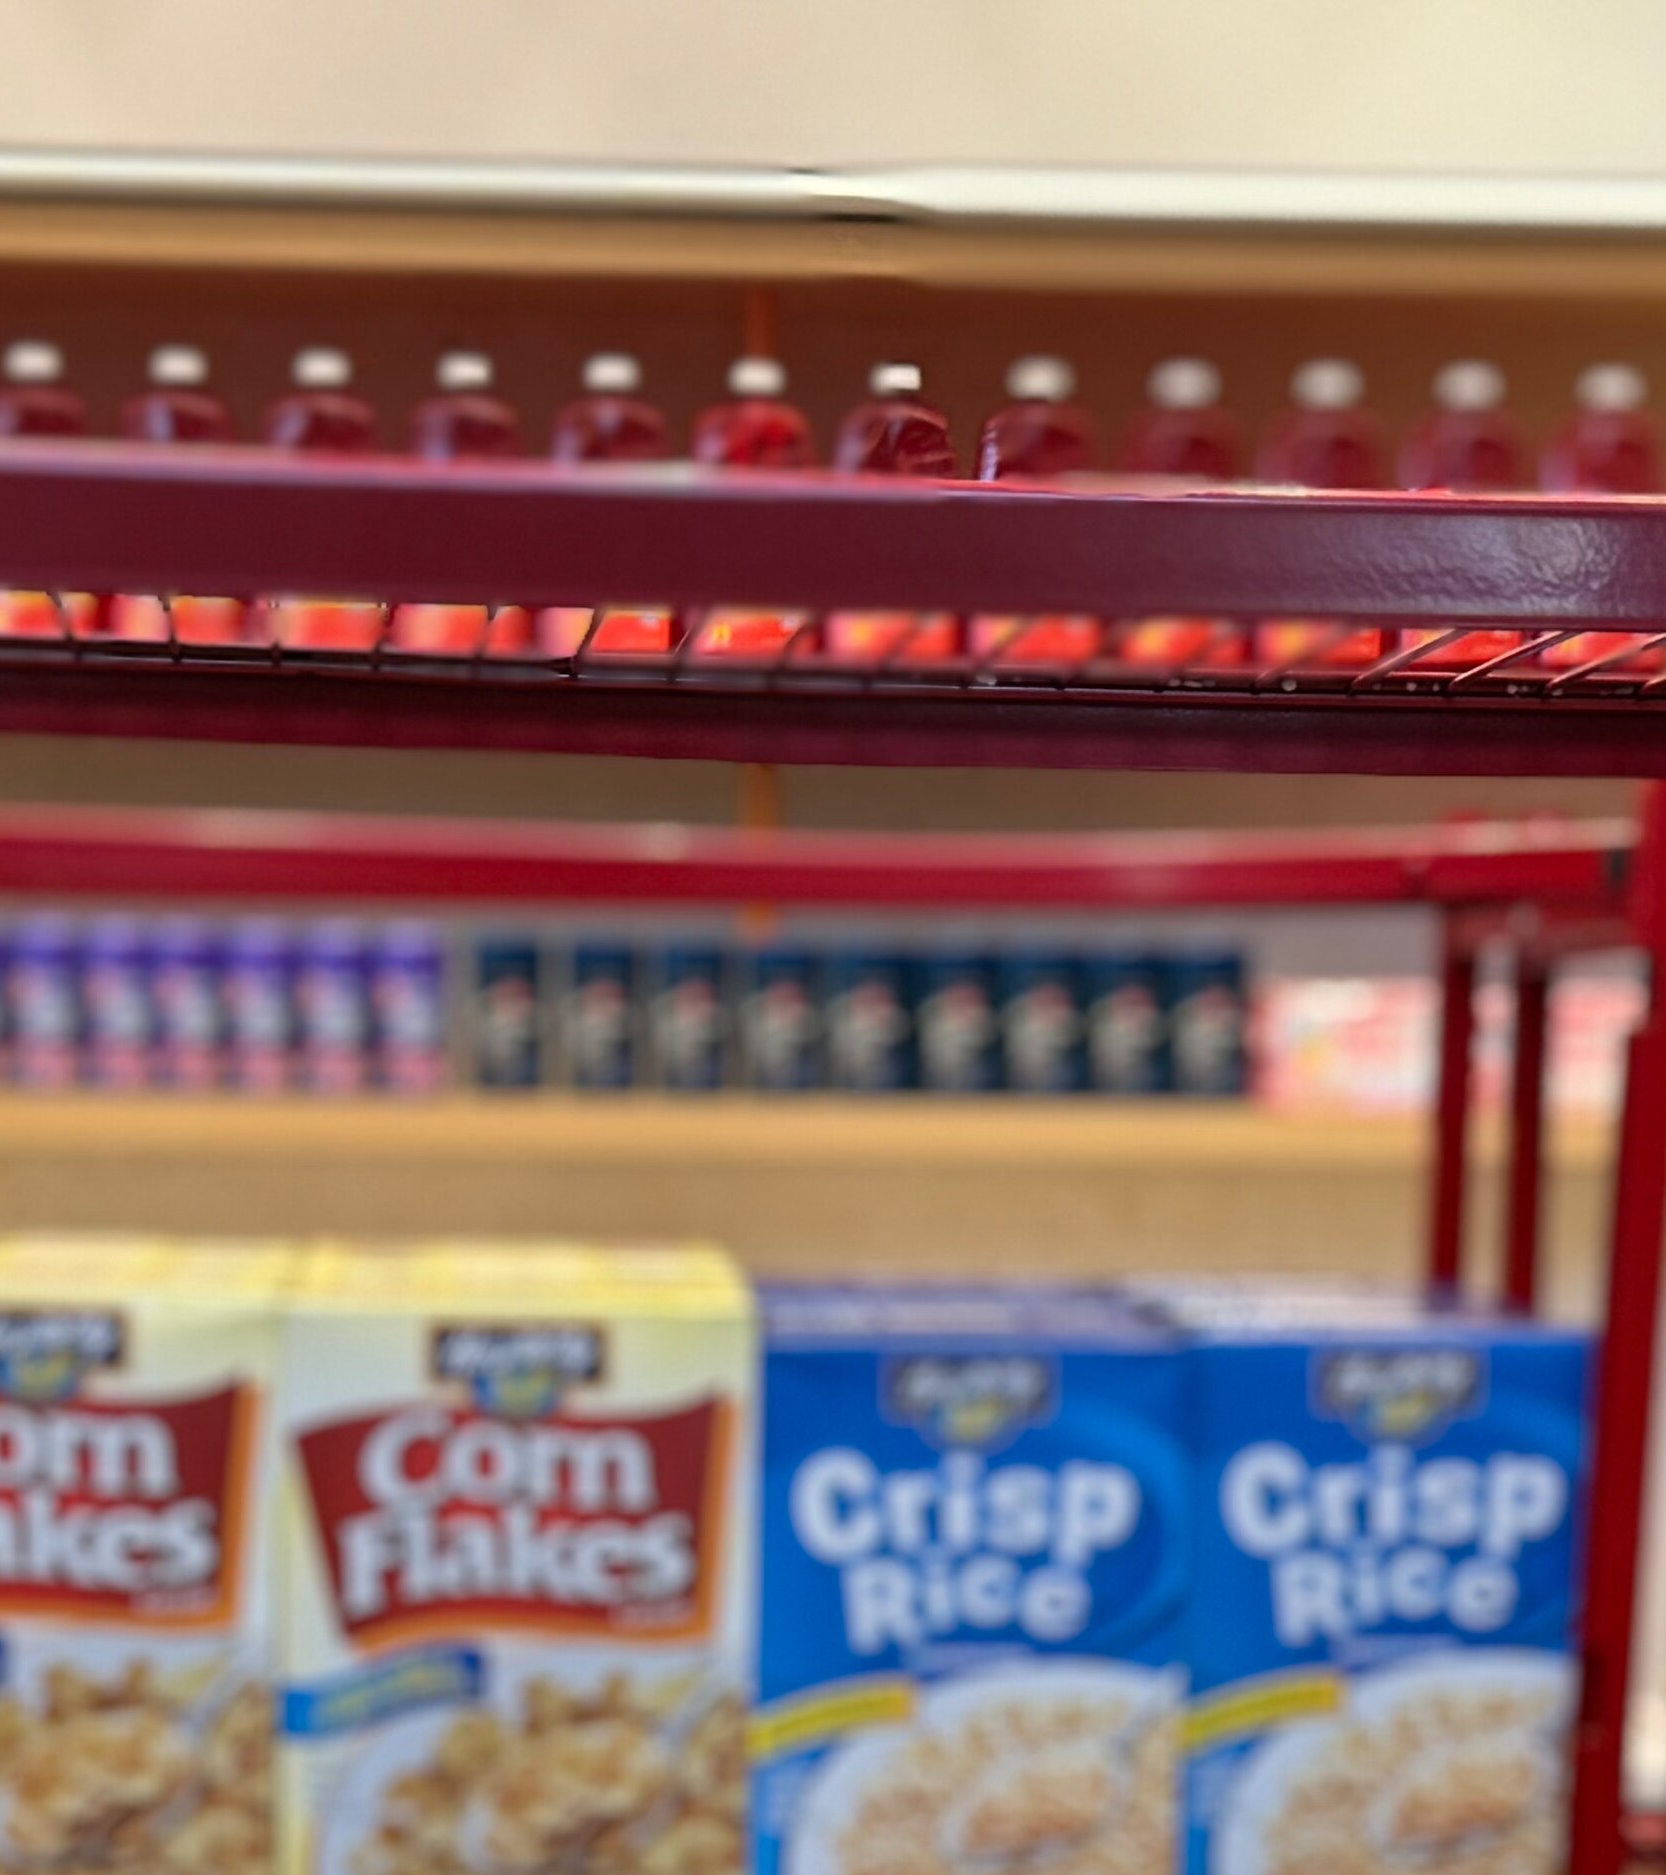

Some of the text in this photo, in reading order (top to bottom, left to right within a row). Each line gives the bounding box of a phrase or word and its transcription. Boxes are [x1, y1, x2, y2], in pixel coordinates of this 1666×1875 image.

[358, 1414, 656, 1515] Corn
[790, 1445, 1141, 1567] Crisp
[1219, 1439, 1568, 1564] Crisp
[340, 1505, 698, 1624] Flakes
[841, 1550, 1092, 1656] Rice
[1269, 1543, 1518, 1648] Rice
